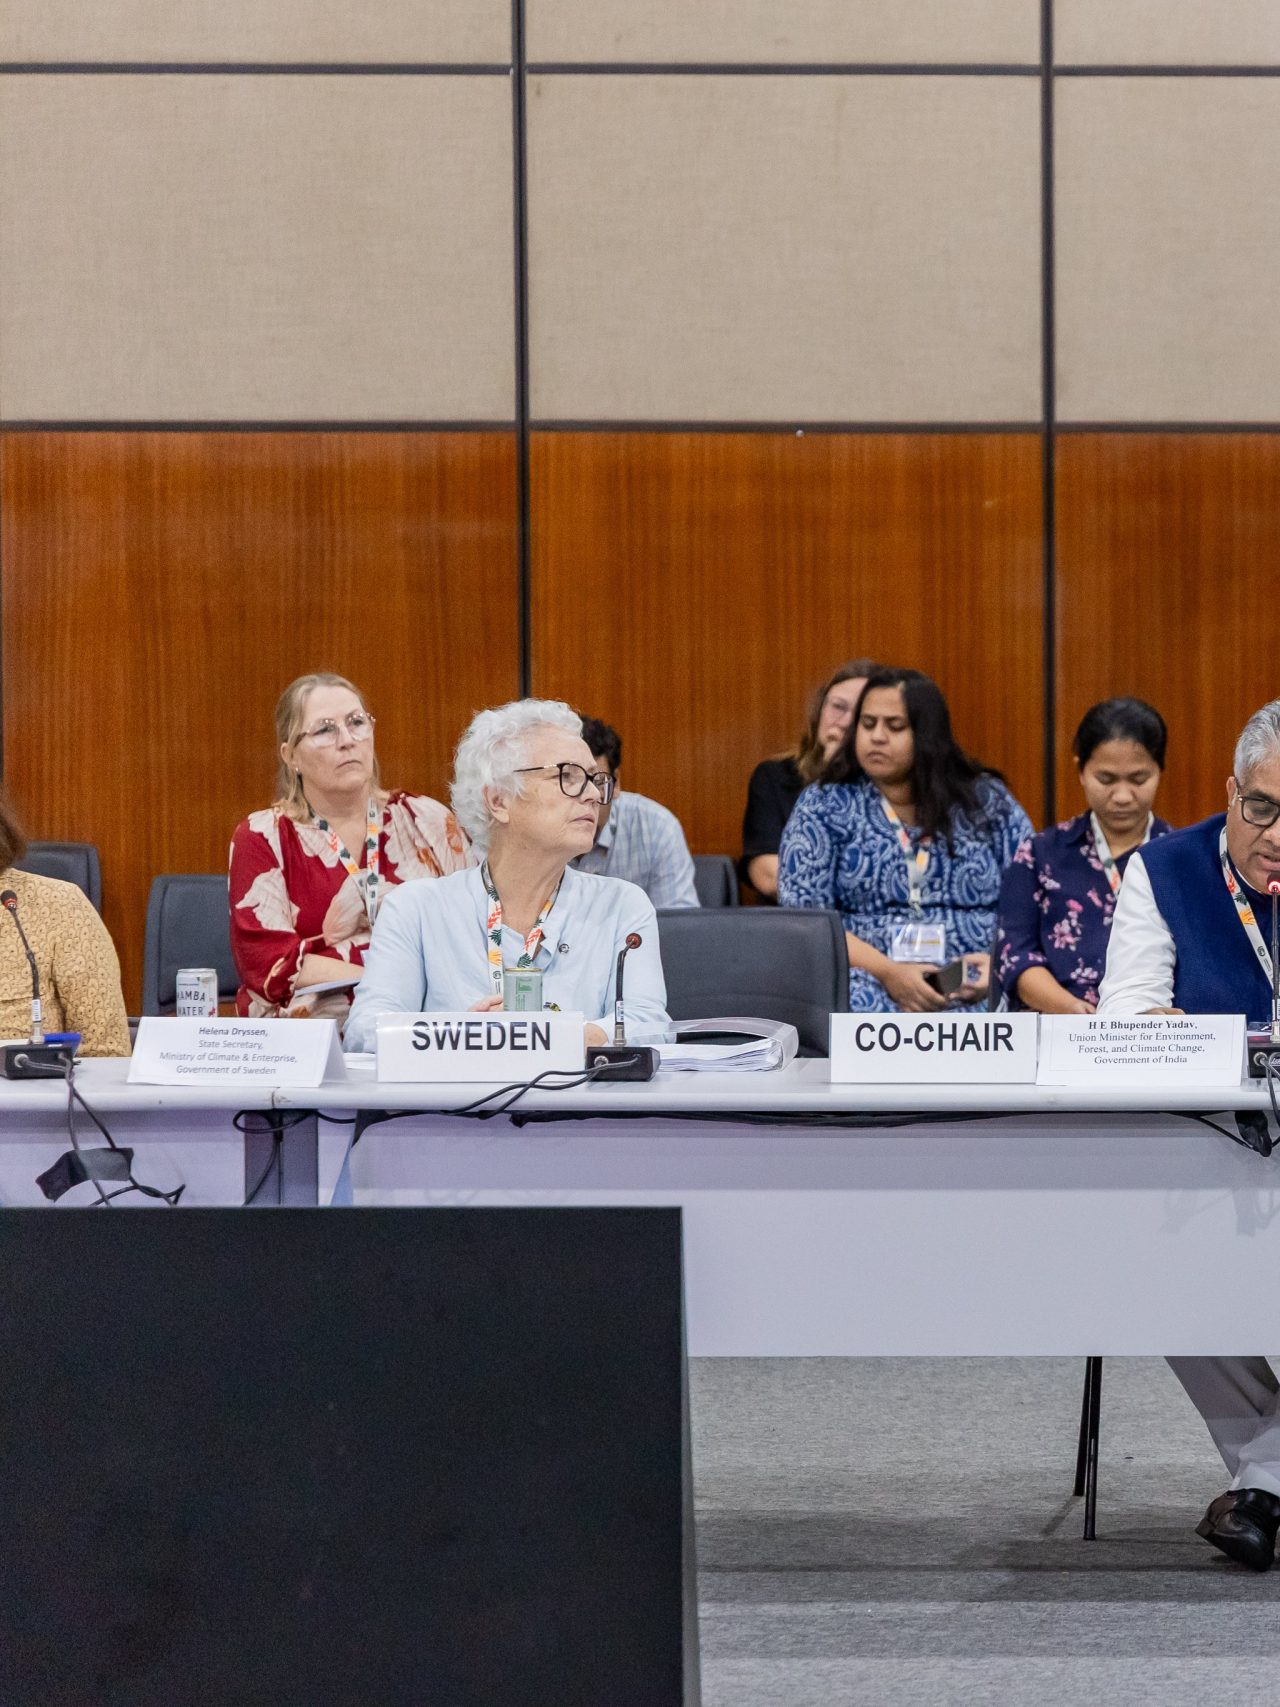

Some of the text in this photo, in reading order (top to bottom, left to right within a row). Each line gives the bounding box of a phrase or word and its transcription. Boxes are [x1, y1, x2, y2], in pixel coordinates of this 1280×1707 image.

[1089, 1020, 1198, 1031] H E Bhupender Yadav,
[198, 1026, 268, 1037] Helena Dryssen,
[411, 1021, 551, 1051] SWEDEN
[855, 1022, 1014, 1052] CO-CHAIR
[1069, 1032, 1216, 1042] Union Minister for Environment,
[198, 1040, 220, 1049] State
[1078, 1043, 1205, 1054] Forest, and Climate Change,
[159, 1052, 298, 1064] Ministry of Climate & Enterprise,
[1094, 1055, 1188, 1065] Government of India
[176, 1065, 276, 1075] Government of Sweden
